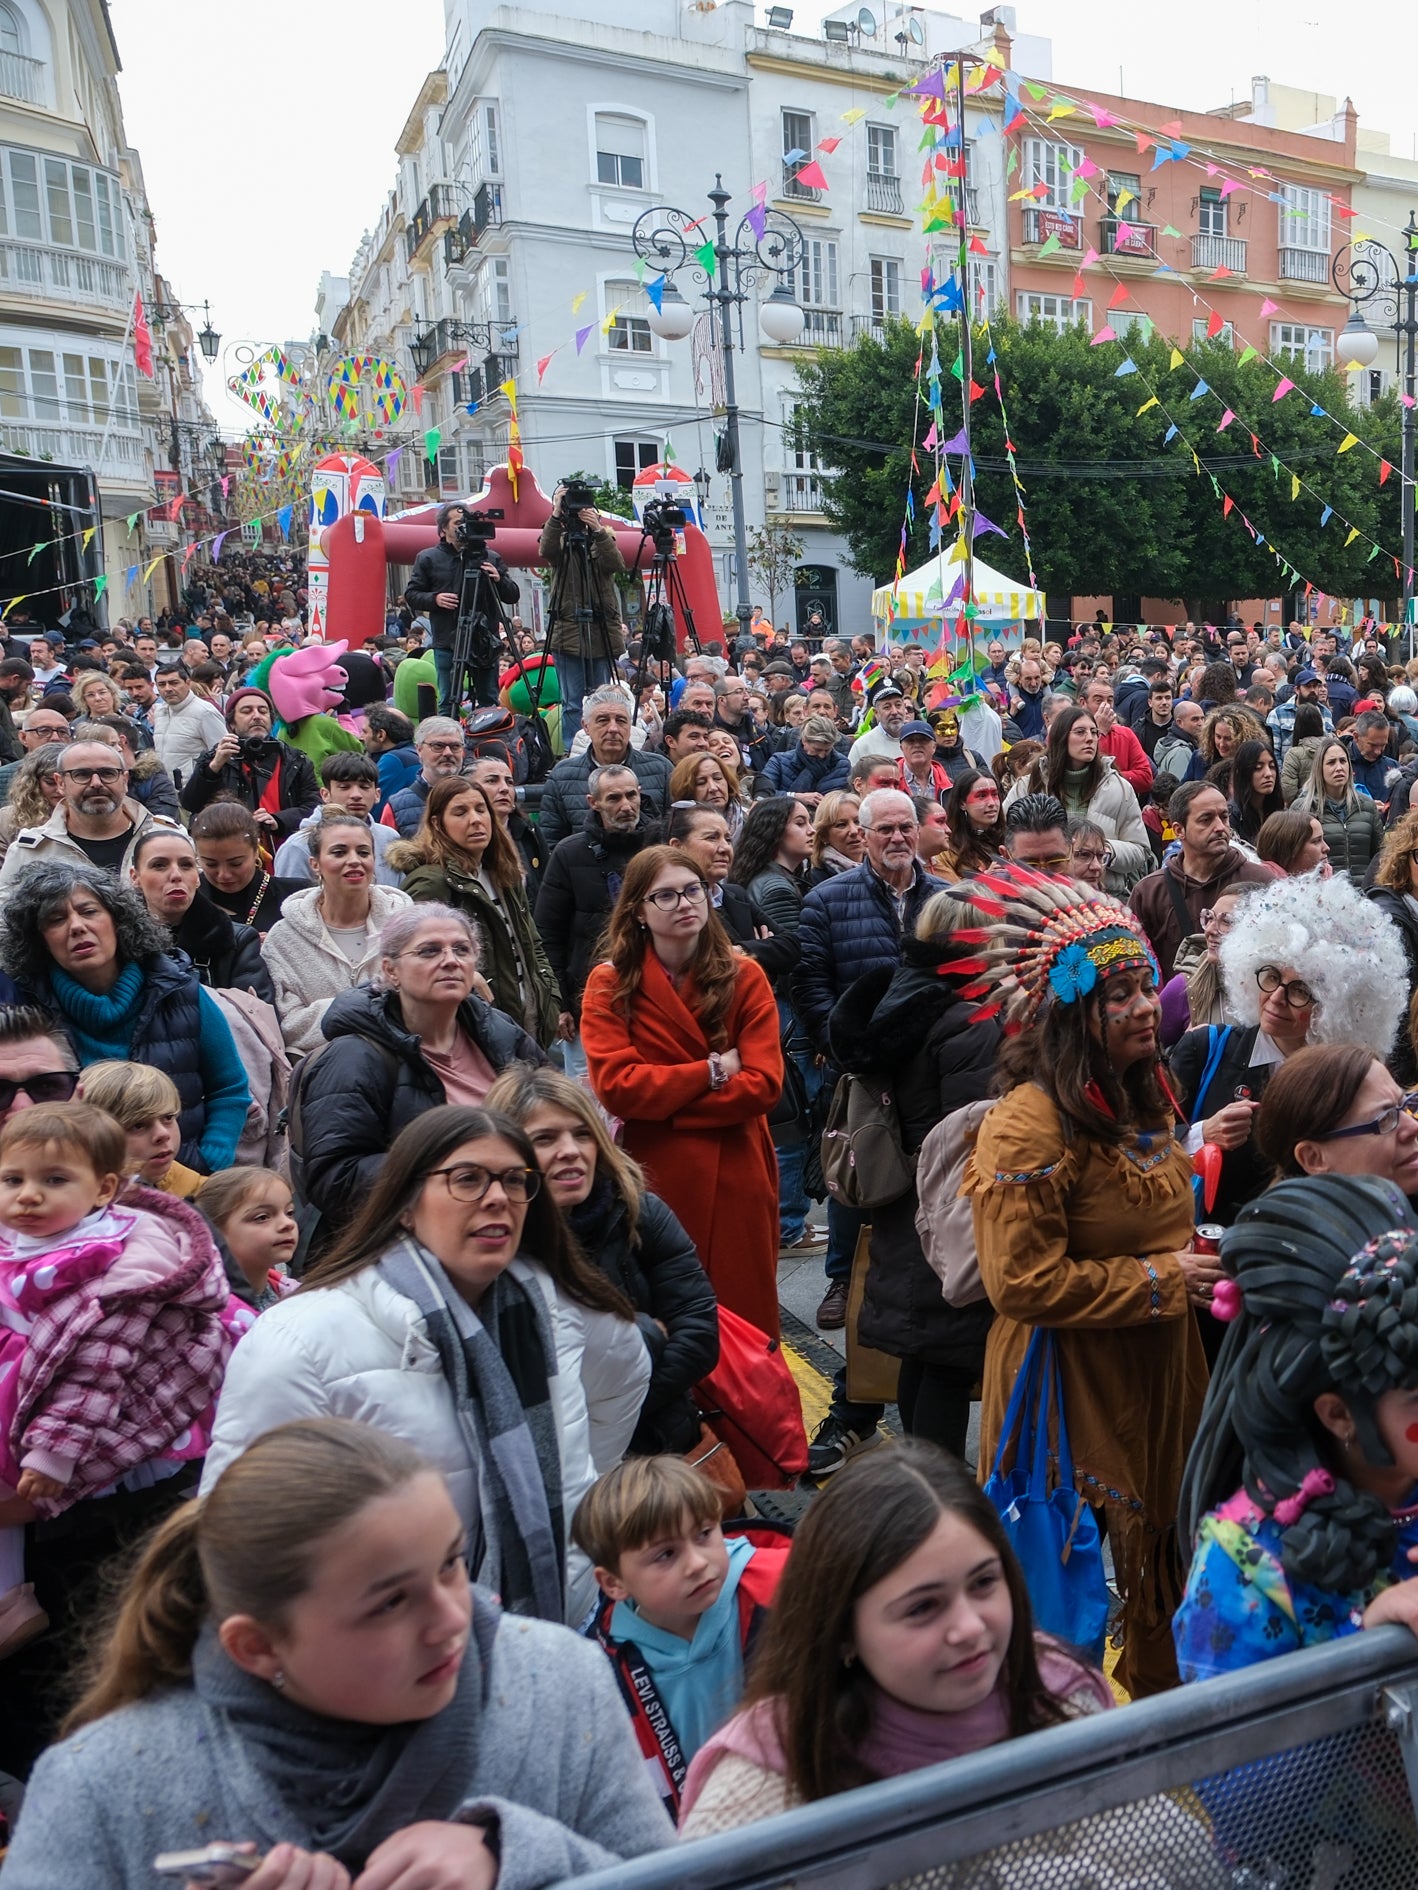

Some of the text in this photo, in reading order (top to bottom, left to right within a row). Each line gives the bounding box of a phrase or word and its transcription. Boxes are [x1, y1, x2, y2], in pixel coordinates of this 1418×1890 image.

[630, 1666, 656, 1702] LEVI
[644, 1700, 681, 1769] STRAUSS
[672, 1766, 686, 1782] &
